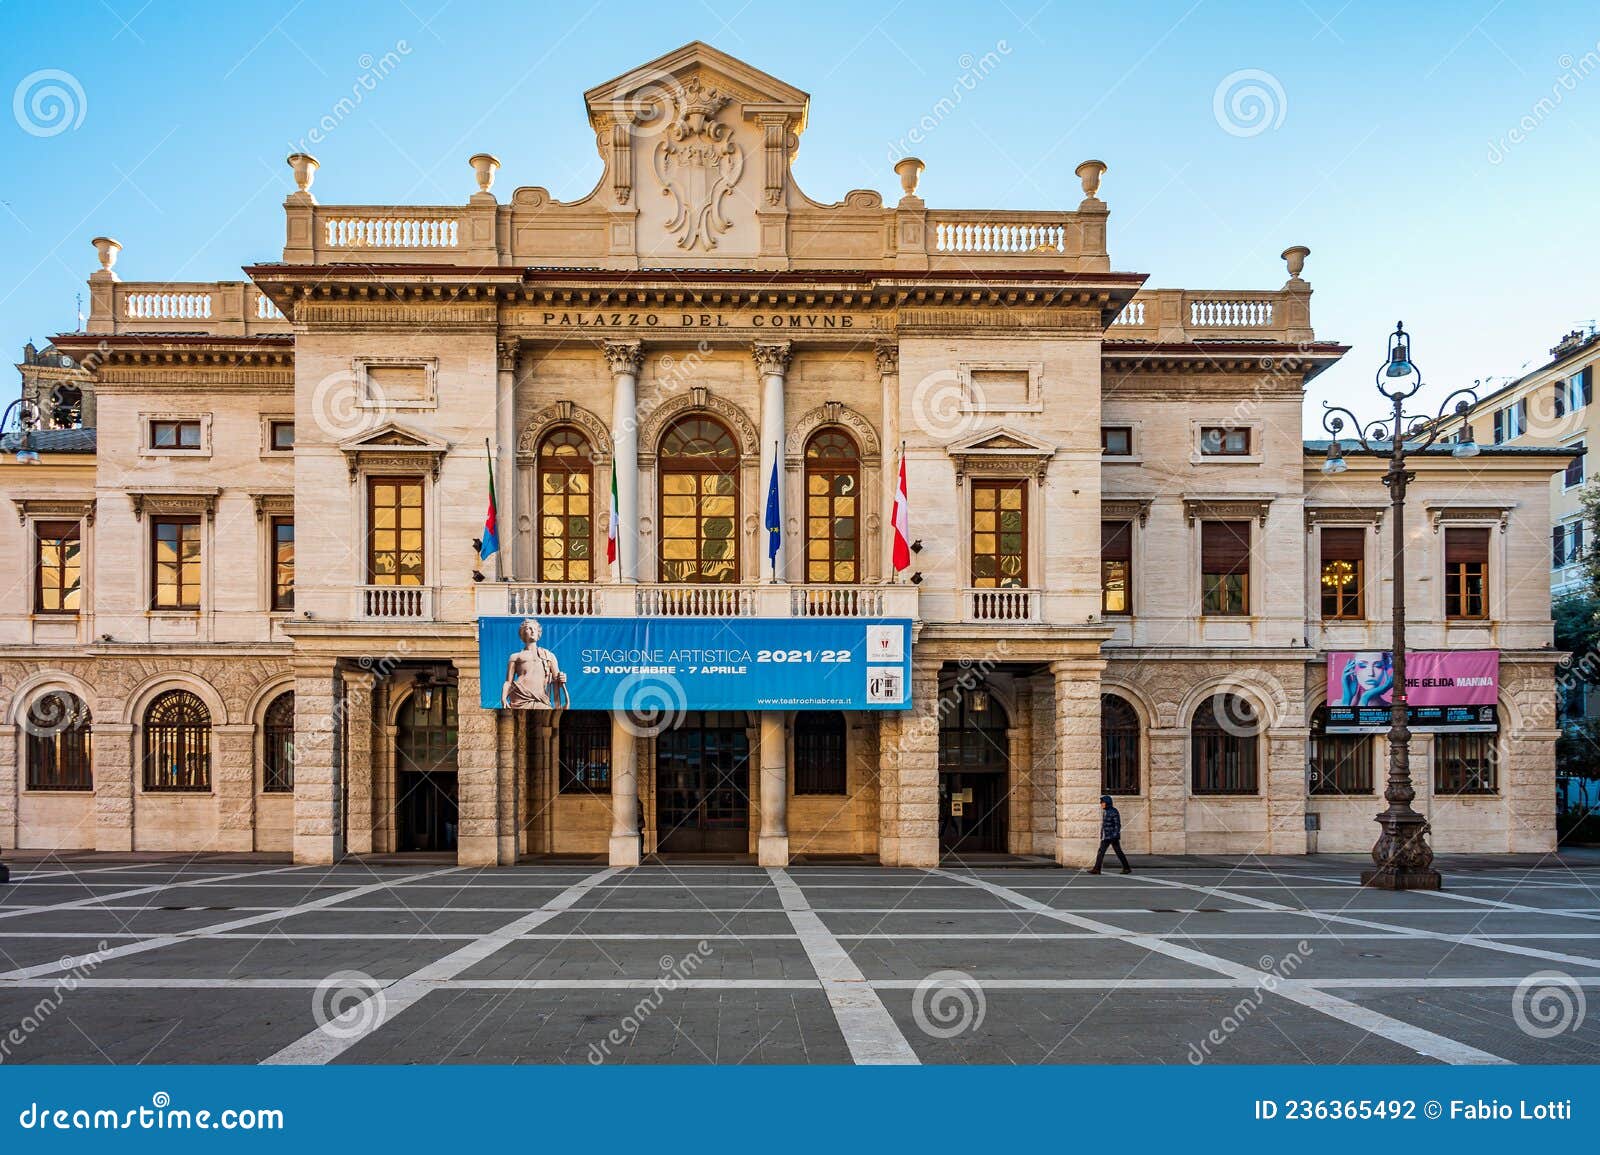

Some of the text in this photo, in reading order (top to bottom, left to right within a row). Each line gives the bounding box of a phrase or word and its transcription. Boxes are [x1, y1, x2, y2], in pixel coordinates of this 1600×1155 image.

[543, 313, 854, 328] PALAZZO DEL COMVNE
[581, 649, 851, 663] STAGIONE ARTISTICA 2021/22
[582, 666, 600, 674] 30
[604, 666, 676, 674] NOVEMBRE
[688, 666, 696, 674] 7
[701, 666, 747, 674] APRILE
[1421, 677, 1454, 688] GELIDA
[1456, 676, 1494, 687] MANINA
[757, 697, 852, 705] www.teatrochiabrera.it
